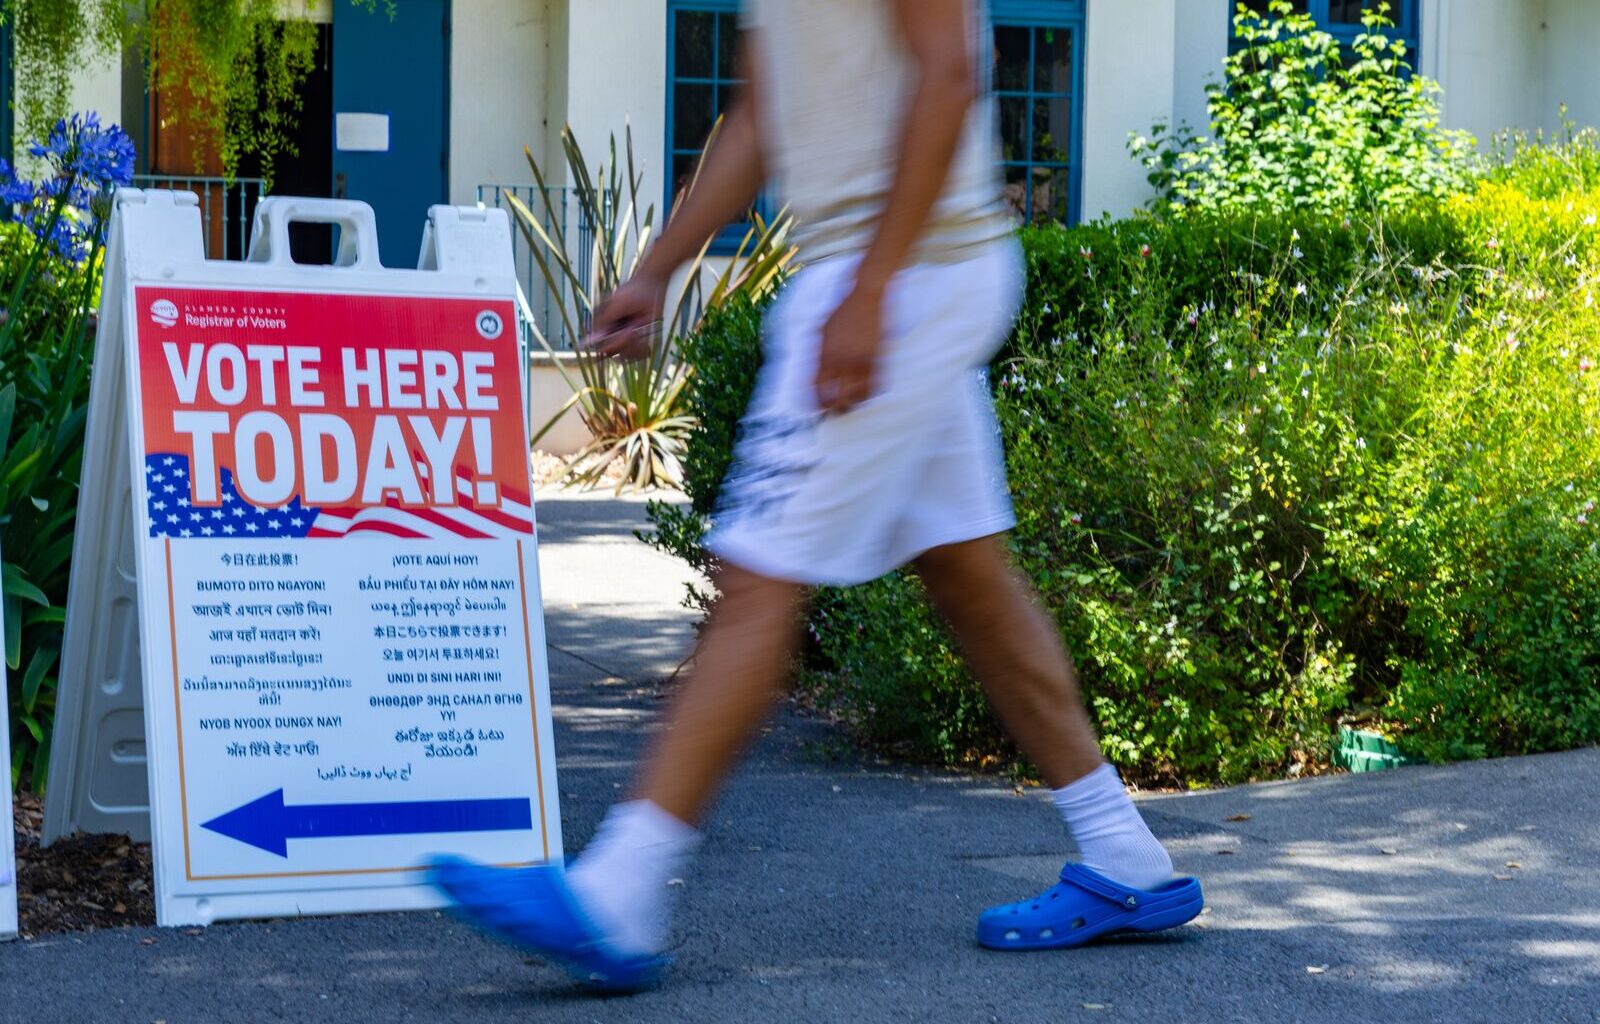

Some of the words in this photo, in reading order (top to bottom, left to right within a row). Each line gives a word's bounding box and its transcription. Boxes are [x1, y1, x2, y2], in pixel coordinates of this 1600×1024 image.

[185, 313, 235, 328] Registrar
[237, 315, 249, 328] of
[250, 315, 286, 329] Voters
[162, 341, 326, 407] VOTE
[340, 346, 500, 412] HERE
[172, 410, 500, 507] TODAY!
[426, 554, 450, 566] AQUÍ
[454, 555, 478, 565] HOY!
[197, 581, 245, 591] BUMOTO
[249, 580, 274, 591] DITO
[278, 580, 325, 591] NGAYON!
[420, 580, 437, 593] TẠI
[440, 578, 460, 590] ĐÂY
[463, 578, 488, 590] HÔM
[491, 580, 514, 590] NAY!
[209, 630, 233, 642] आज
[236, 626, 257, 642] यहाँ
[259, 630, 296, 642] मतदान
[383, 648, 403, 661] 오늘
[407, 648, 439, 661] 여기서
[443, 647, 499, 661] 투표하세요!
[388, 673, 414, 683] UNDI
[417, 673, 428, 683] DI
[431, 672, 452, 683] SINI
[455, 672, 480, 682] HARI
[484, 672, 501, 682] INI!
[370, 695, 423, 708] ӨНӨӨДӨР
[427, 695, 450, 708] ЭНД
[453, 694, 491, 705] САНАЛ
[494, 693, 522, 705] ӨГНӨ
[200, 718, 230, 730] NYOB
[234, 717, 272, 729] NYOOX
[275, 717, 313, 728] DUNGX
[317, 716, 341, 727] NAY!
